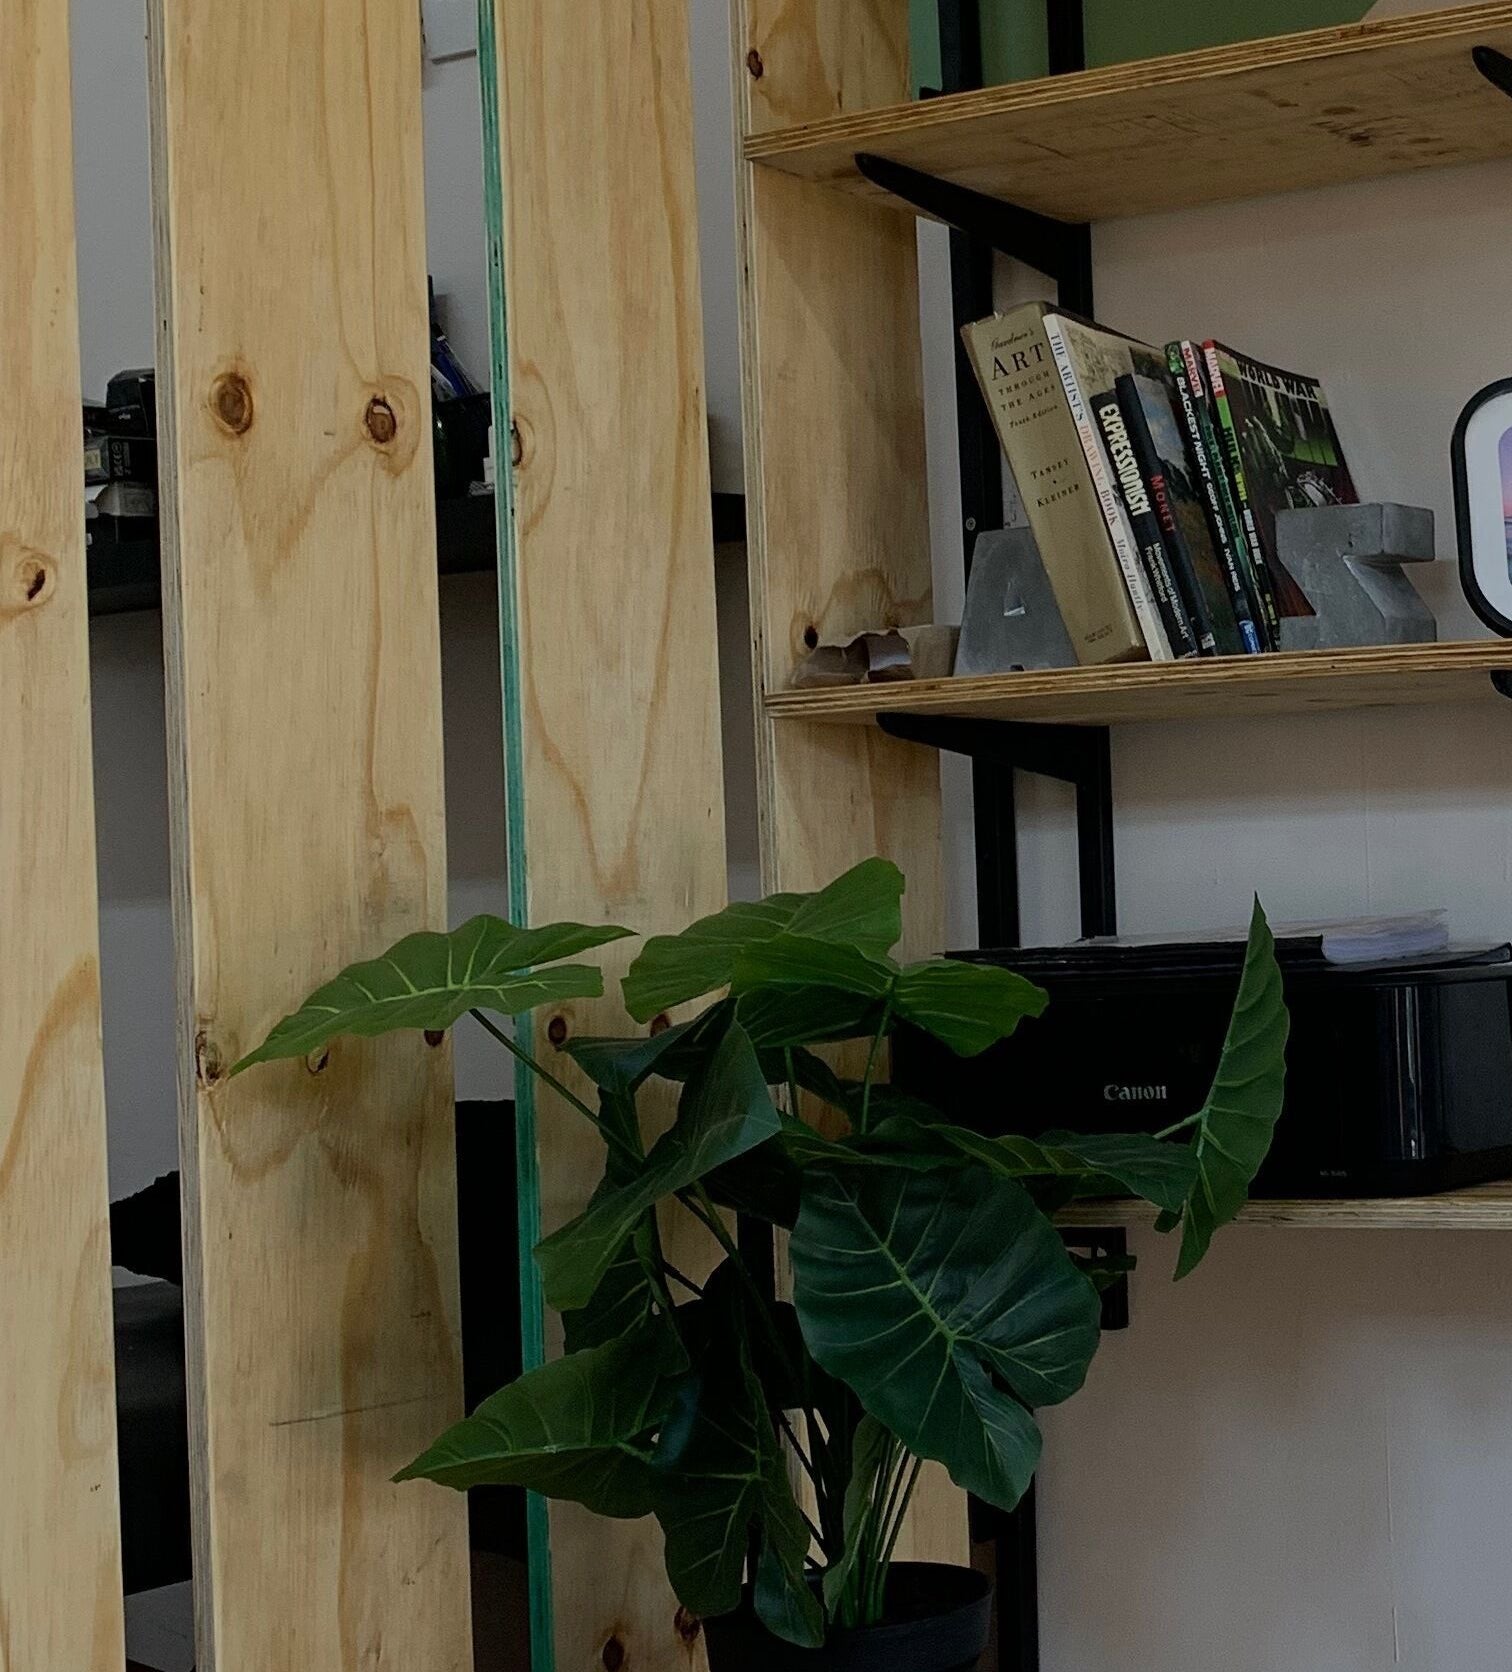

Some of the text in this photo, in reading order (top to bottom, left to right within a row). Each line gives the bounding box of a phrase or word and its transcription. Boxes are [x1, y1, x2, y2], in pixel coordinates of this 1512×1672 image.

[992, 342, 1044, 381] ART
[998, 371, 1050, 396] THROUGH
[1182, 347, 1203, 394] MARVEL
[1204, 347, 1225, 392] MARVEL
[1236, 361, 1317, 401] WORLD WAR
[1001, 385, 1056, 412] THE AGES
[1050, 334, 1065, 356] THE
[1060, 365, 1084, 421] ARTIST'S
[1079, 425, 1105, 487] DRAWING
[1100, 489, 1118, 526] BOOK
[1176, 376, 1212, 480] BLACKEST NIGHT
[1098, 402, 1152, 517] EXPRESSIONISM
[1150, 474, 1177, 532] MONET
[1145, 545, 1158, 569] Frank
[1152, 542, 1191, 639] Movements of Modern Art
[1103, 1084, 1167, 1100] Canon
